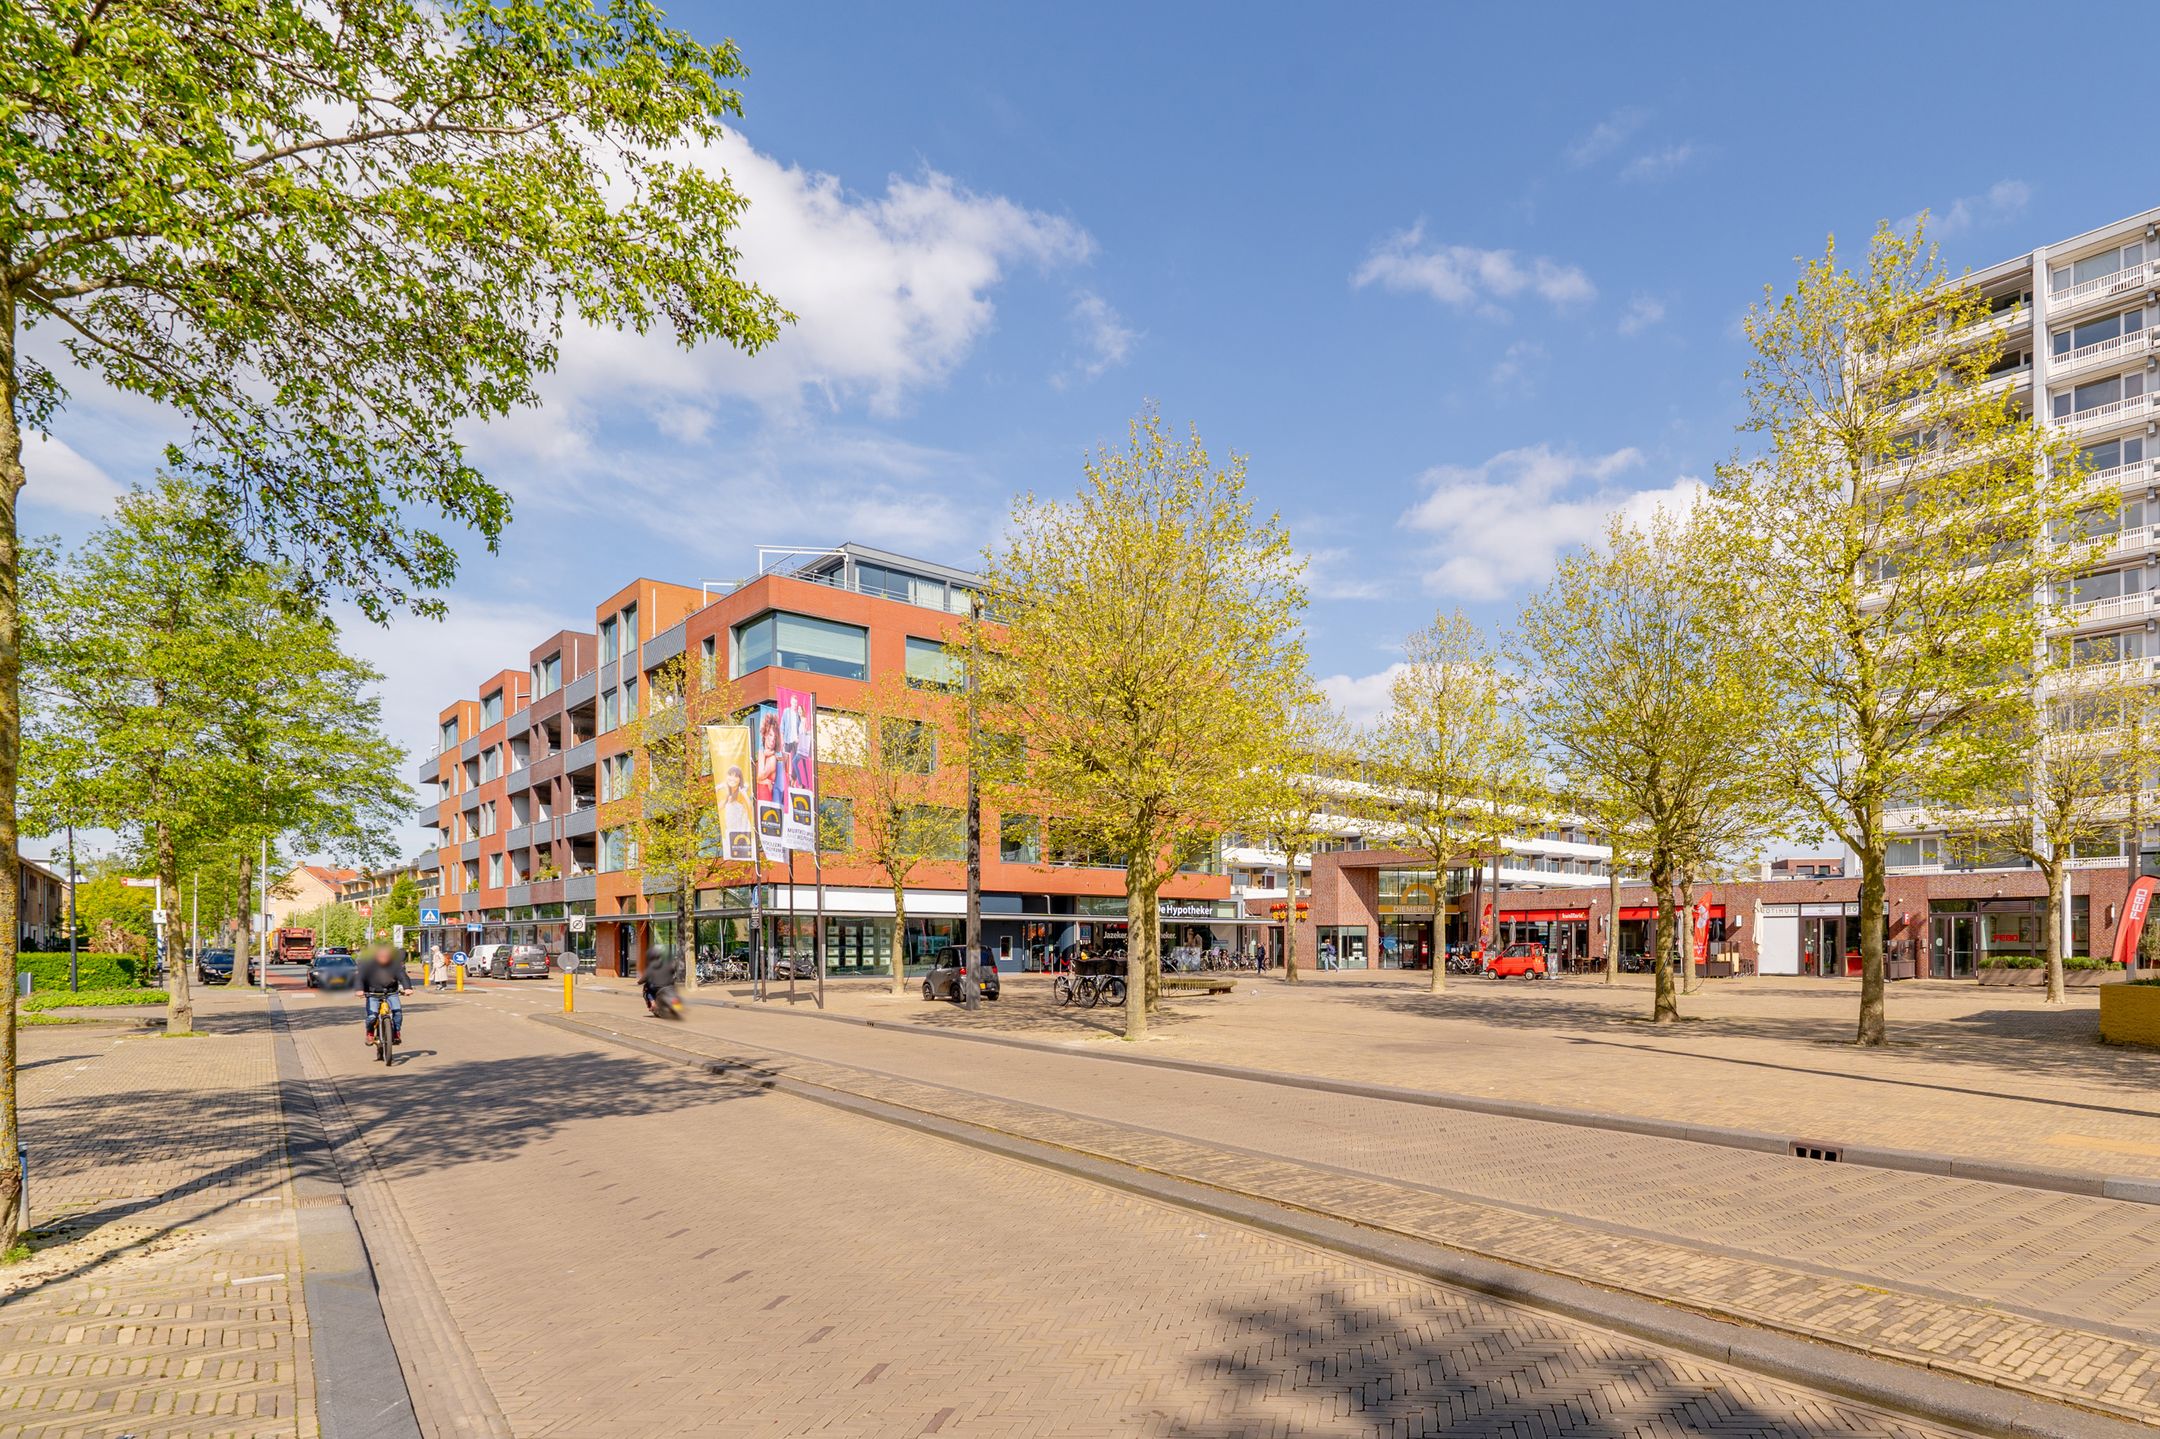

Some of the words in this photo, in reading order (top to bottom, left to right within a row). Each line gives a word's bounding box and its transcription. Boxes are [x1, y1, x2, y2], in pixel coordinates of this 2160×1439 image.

[1393, 905, 1435, 913] DIEMERPLE
[2129, 888, 2148, 920] FEBO
[1166, 904, 1213, 916] Hypotheker
[1103, 931, 1128, 939] Jazeker.
